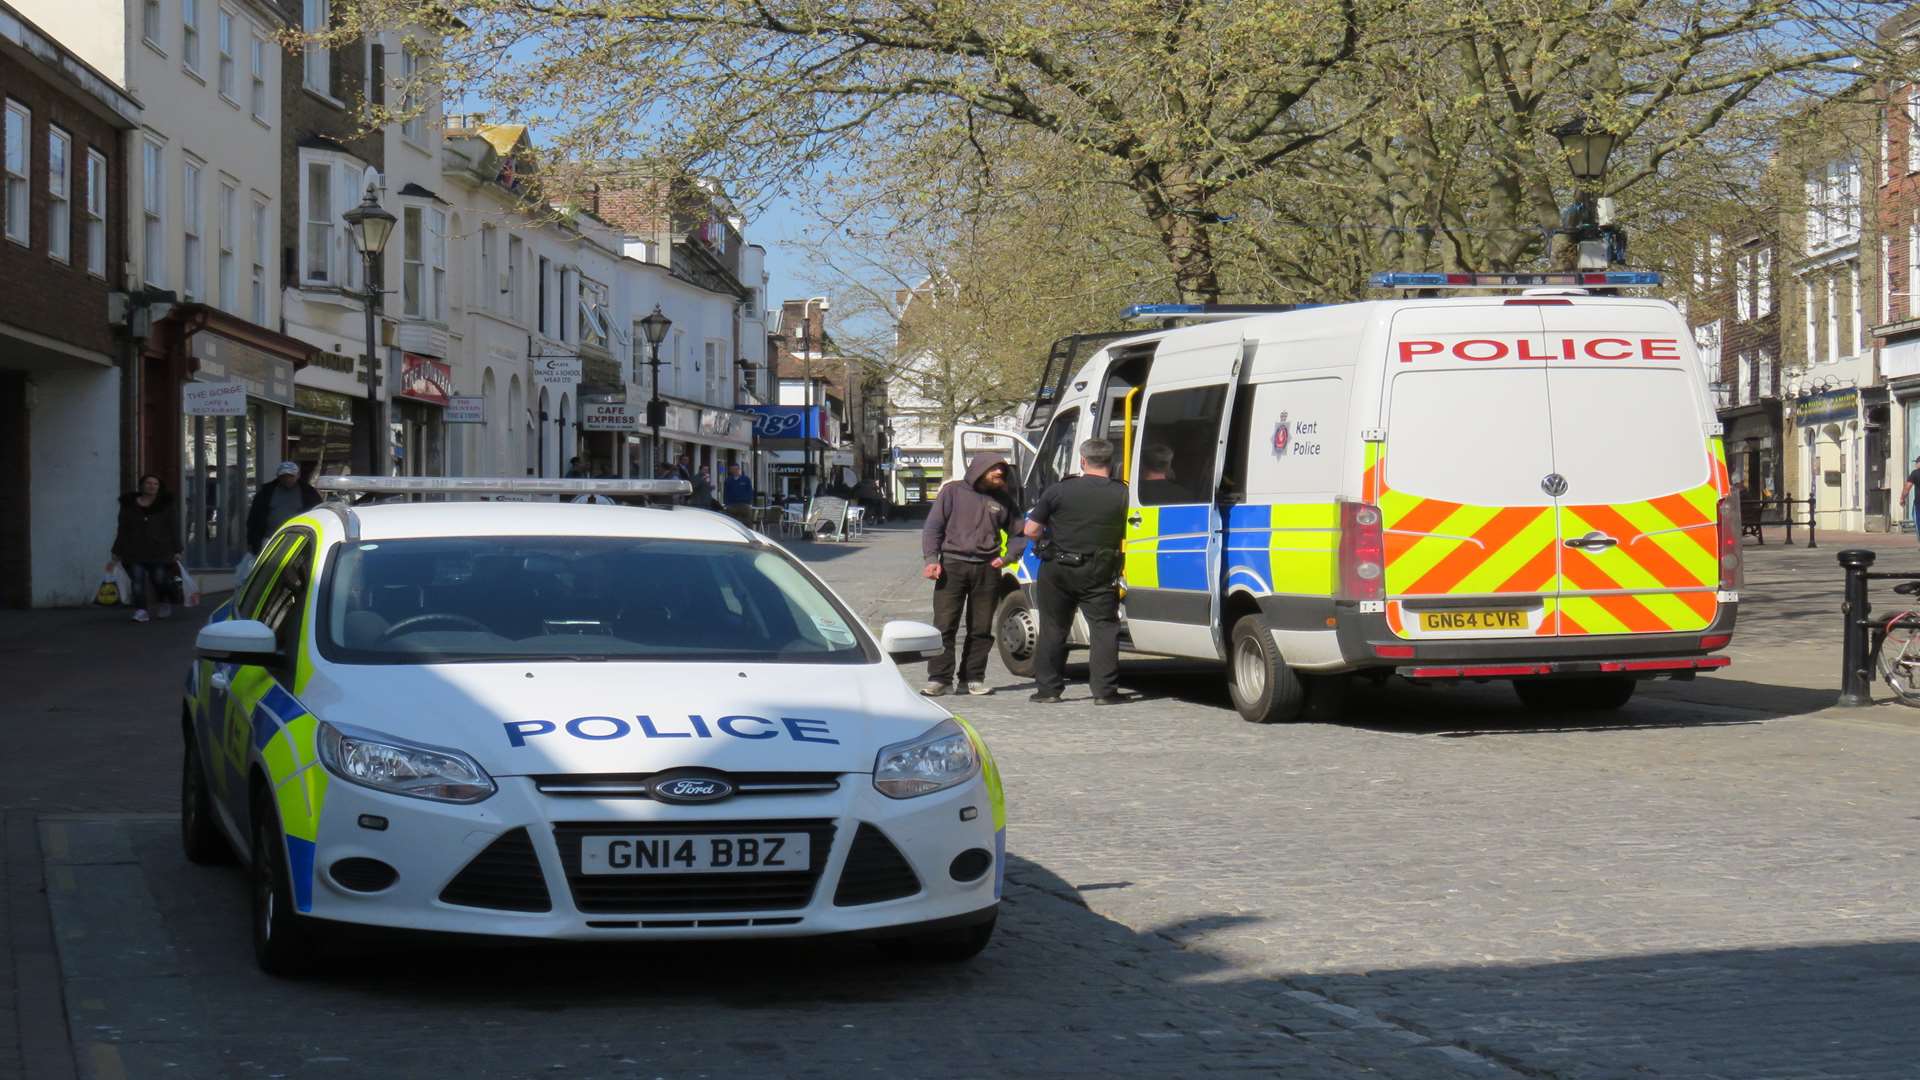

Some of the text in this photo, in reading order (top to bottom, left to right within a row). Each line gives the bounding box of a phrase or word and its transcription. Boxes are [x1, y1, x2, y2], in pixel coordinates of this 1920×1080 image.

[1398, 338, 1680, 363] POLICE
[187, 390, 208, 400] THE
[597, 406, 625, 415] CAFE
[587, 415, 635, 424] EXPRESS
[1295, 420, 1317, 434] Kent
[1293, 441, 1321, 455] Police
[1428, 612, 1520, 628] GN64 CVR
[503, 715, 840, 747] POLICE
[673, 780, 715, 795] Ford
[608, 837, 785, 869] GN14 BBZ
